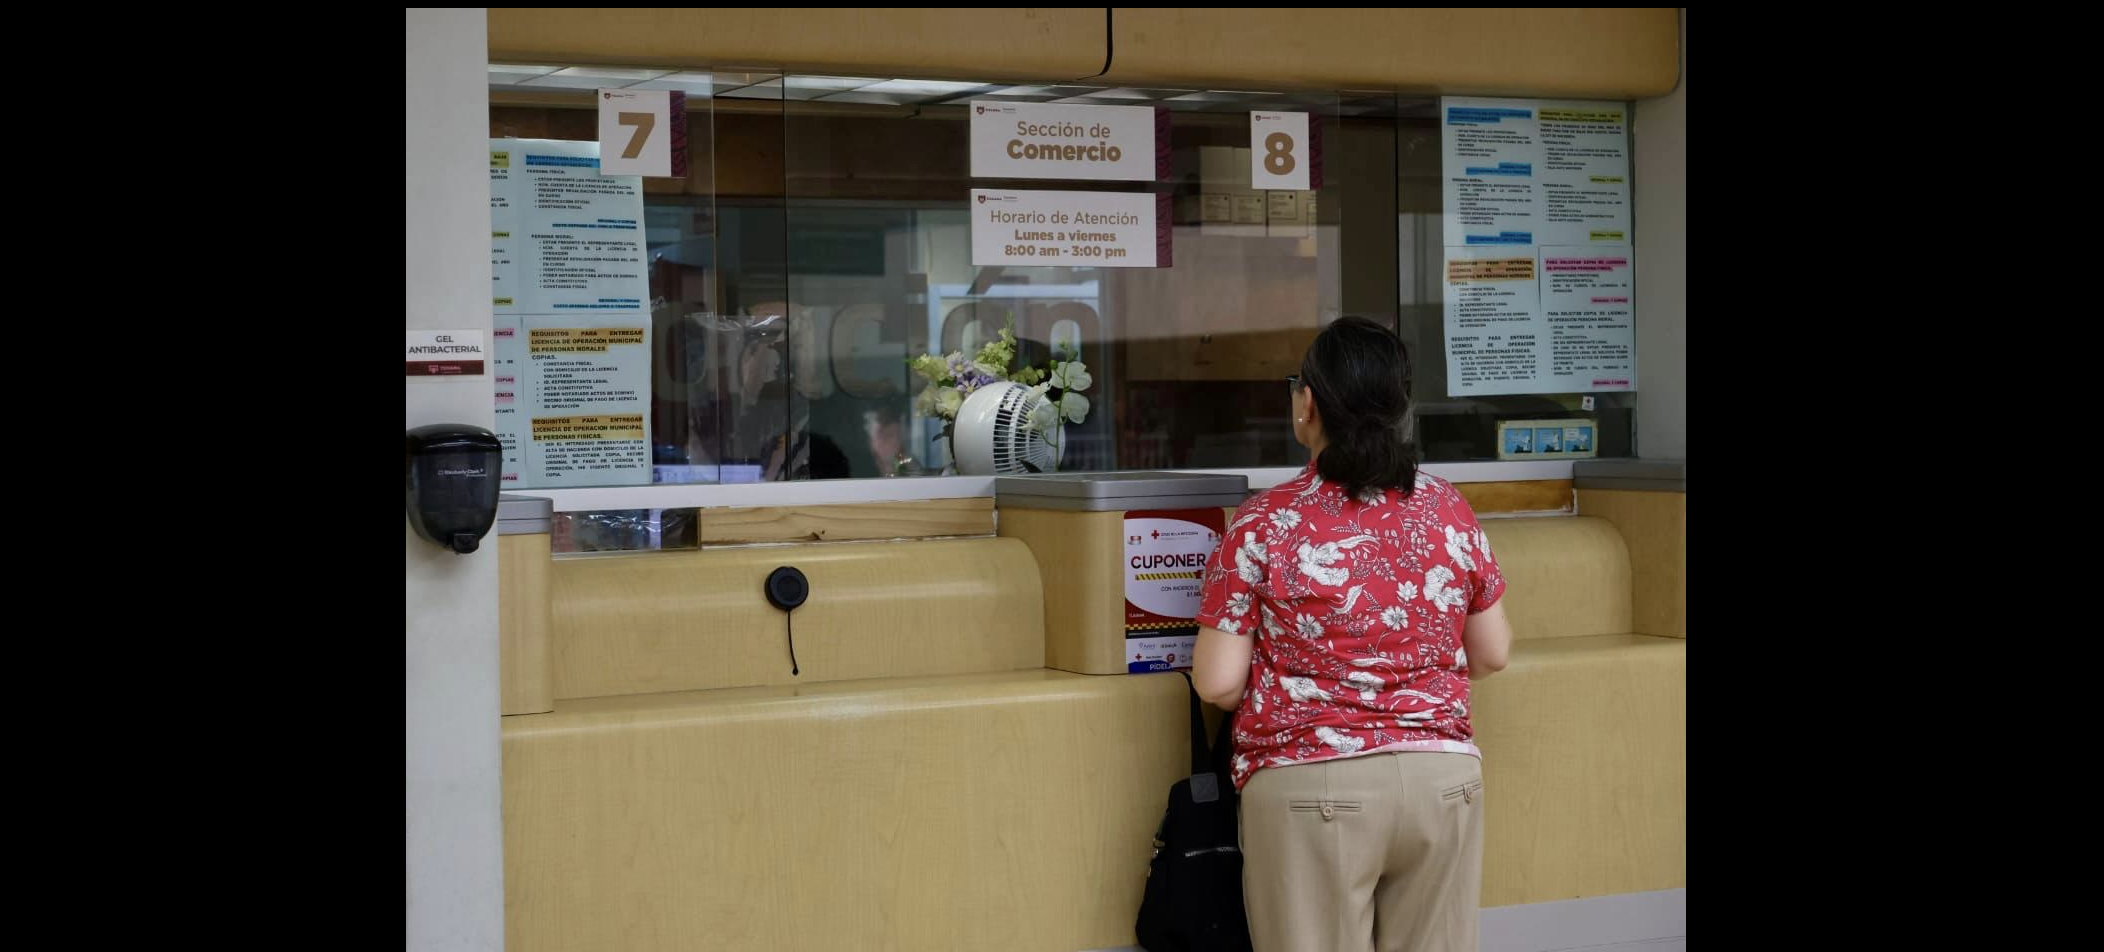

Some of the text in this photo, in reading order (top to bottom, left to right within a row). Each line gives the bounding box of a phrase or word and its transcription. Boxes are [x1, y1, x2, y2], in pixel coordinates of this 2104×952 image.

[618, 112, 655, 159] 7
[1017, 120, 1111, 138] Sección de
[1006, 139, 1122, 162] Comercio
[1264, 132, 1296, 175] 8
[990, 210, 1139, 225] Horario de Atención
[1014, 229, 1117, 242] Lunes a viernes
[1004, 244, 1036, 256] 8:00
[1038, 247, 1060, 257] am
[1071, 245, 1102, 257] 3:00
[1104, 247, 1127, 259] pm
[436, 335, 454, 343] GEL
[408, 345, 482, 354] ANTIBACTERIAL
